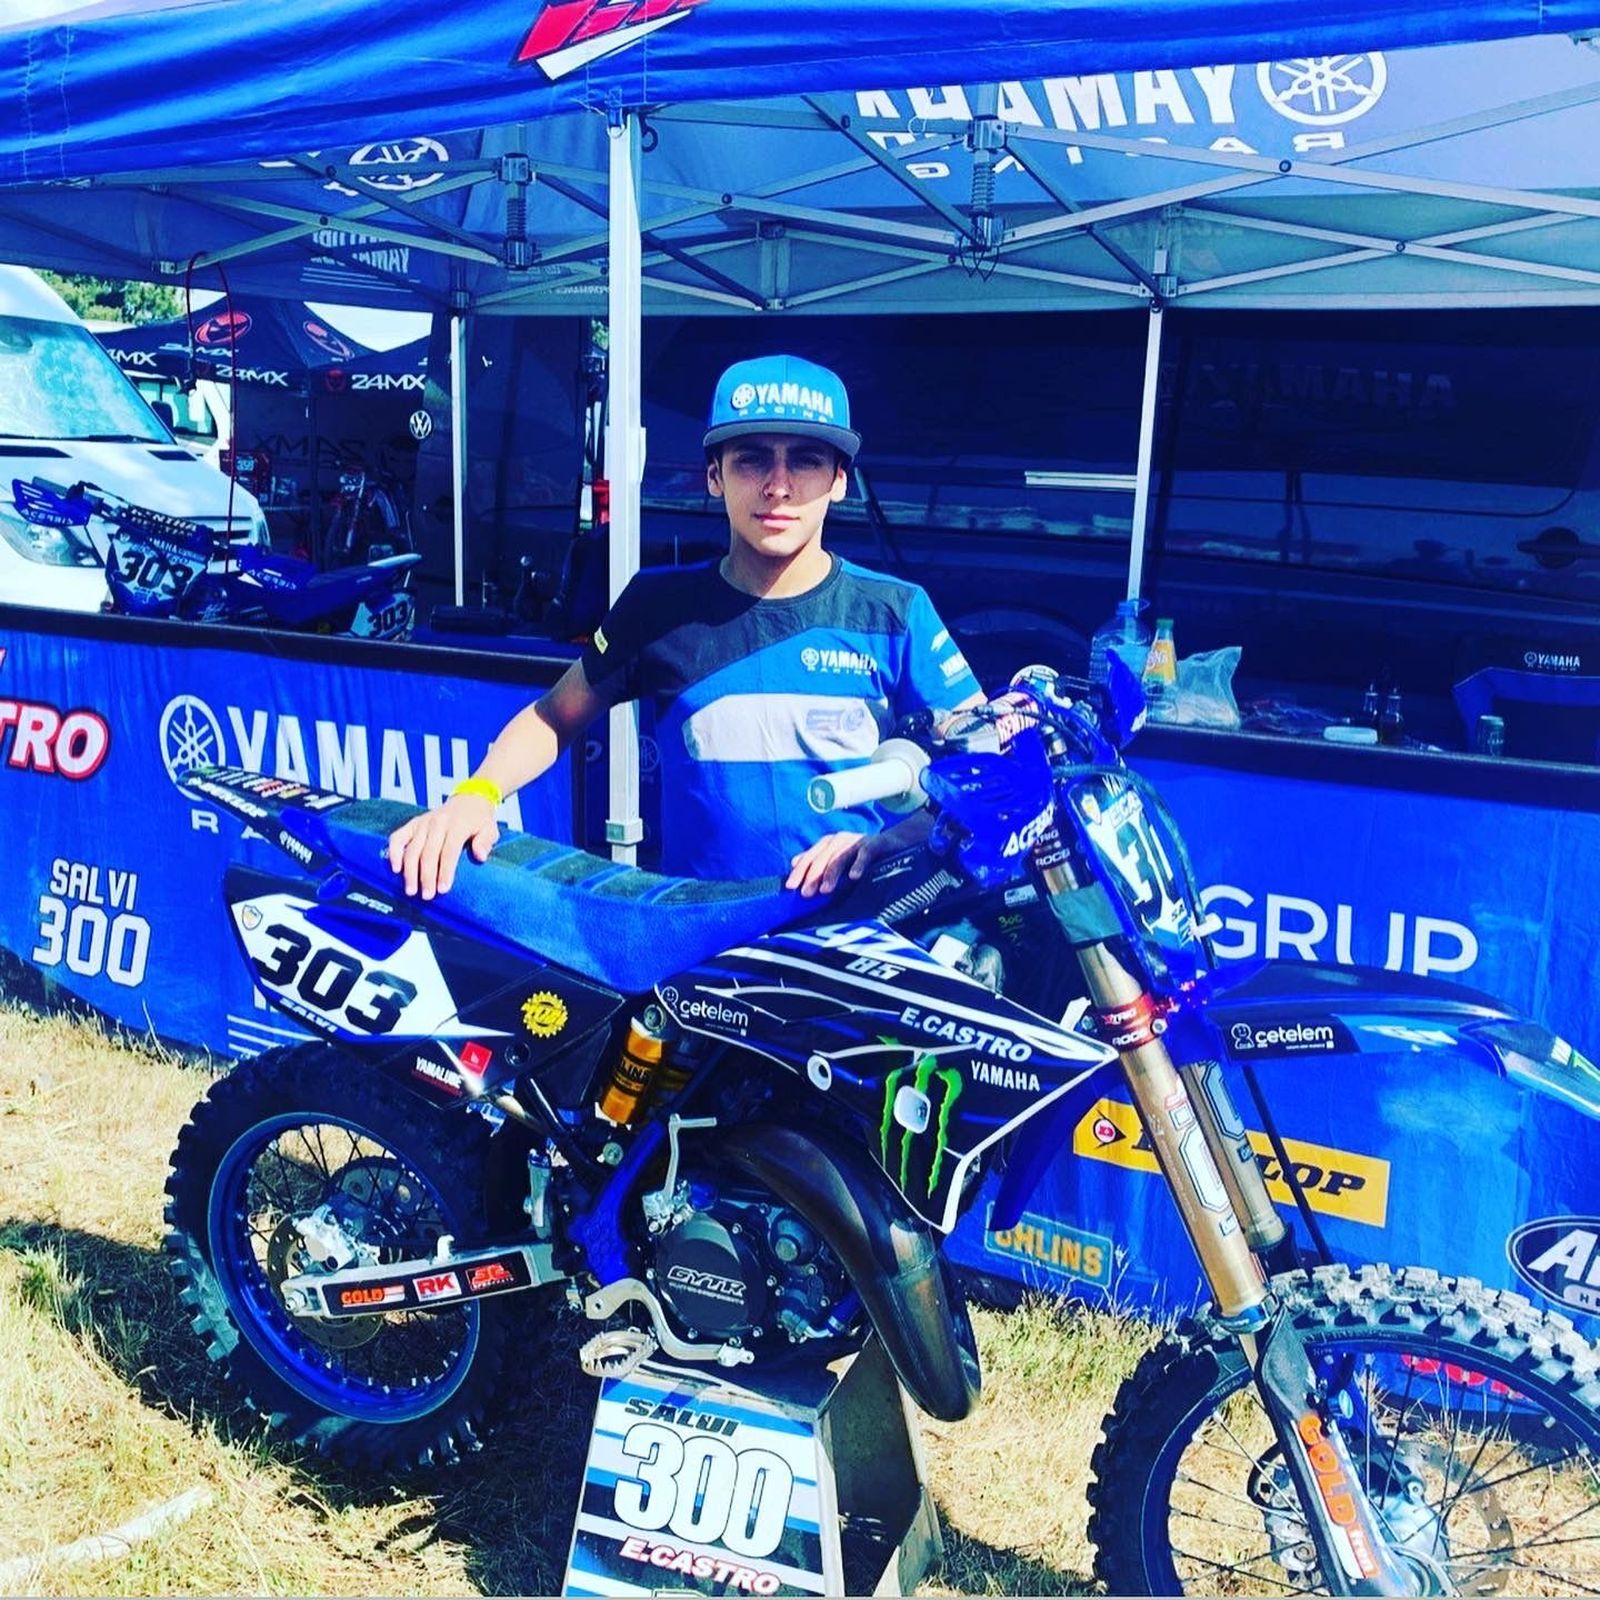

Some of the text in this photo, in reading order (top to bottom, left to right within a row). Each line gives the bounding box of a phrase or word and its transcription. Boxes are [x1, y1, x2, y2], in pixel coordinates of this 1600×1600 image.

[351, 373, 427, 390] 24MX
[756, 383, 834, 418] YAMAHA
[368, 600, 410, 638] 303
[820, 650, 877, 671] YAMAHA
[1538, 653, 1580, 667] YAMAHA
[50, 858, 138, 911] SALVI
[33, 895, 151, 988] 300
[250, 924, 418, 1035] 303
[279, 997, 339, 1034] SALVI
[680, 1000, 750, 1028] cetelem
[899, 1006, 1033, 1063] E.CASTRO
[1255, 1023, 1334, 1048] cetelem
[970, 1060, 1041, 1092] YAMAHA
[340, 1287, 385, 1304] GOLD
[416, 1274, 456, 1295] RK
[667, 1265, 747, 1298] GYTR
[1299, 1413, 1357, 1526] GOLD
[613, 1422, 794, 1559] 300
[618, 1535, 783, 1596] E.CASTRO
